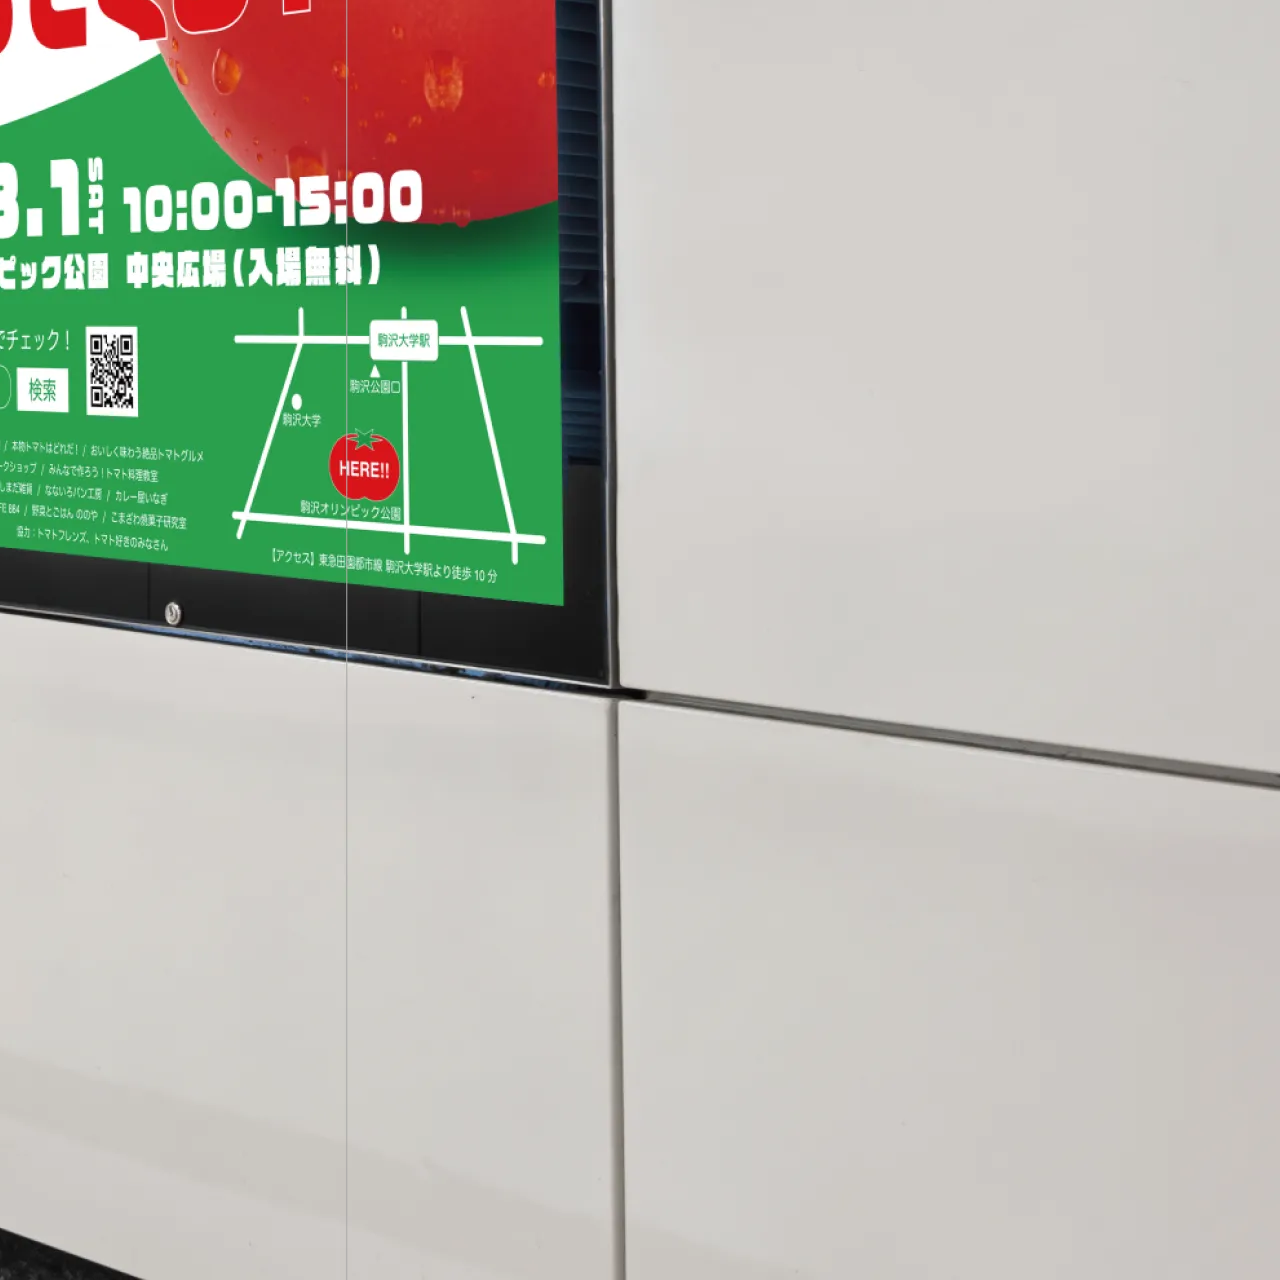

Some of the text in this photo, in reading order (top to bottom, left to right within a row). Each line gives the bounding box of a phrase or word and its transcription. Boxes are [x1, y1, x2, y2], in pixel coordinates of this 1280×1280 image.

[88, 157, 103, 234] SAT
[123, 169, 422, 233] 10:00-15:00
[377, 332, 430, 348] 駒沢大学駅
[28, 377, 56, 402] 検索
[350, 379, 400, 393] 駒沢公園口
[282, 413, 321, 427] 駒沢大学
[339, 460, 389, 478] HERE!!
[300, 499, 401, 521] 駒沢オリンピック公園
